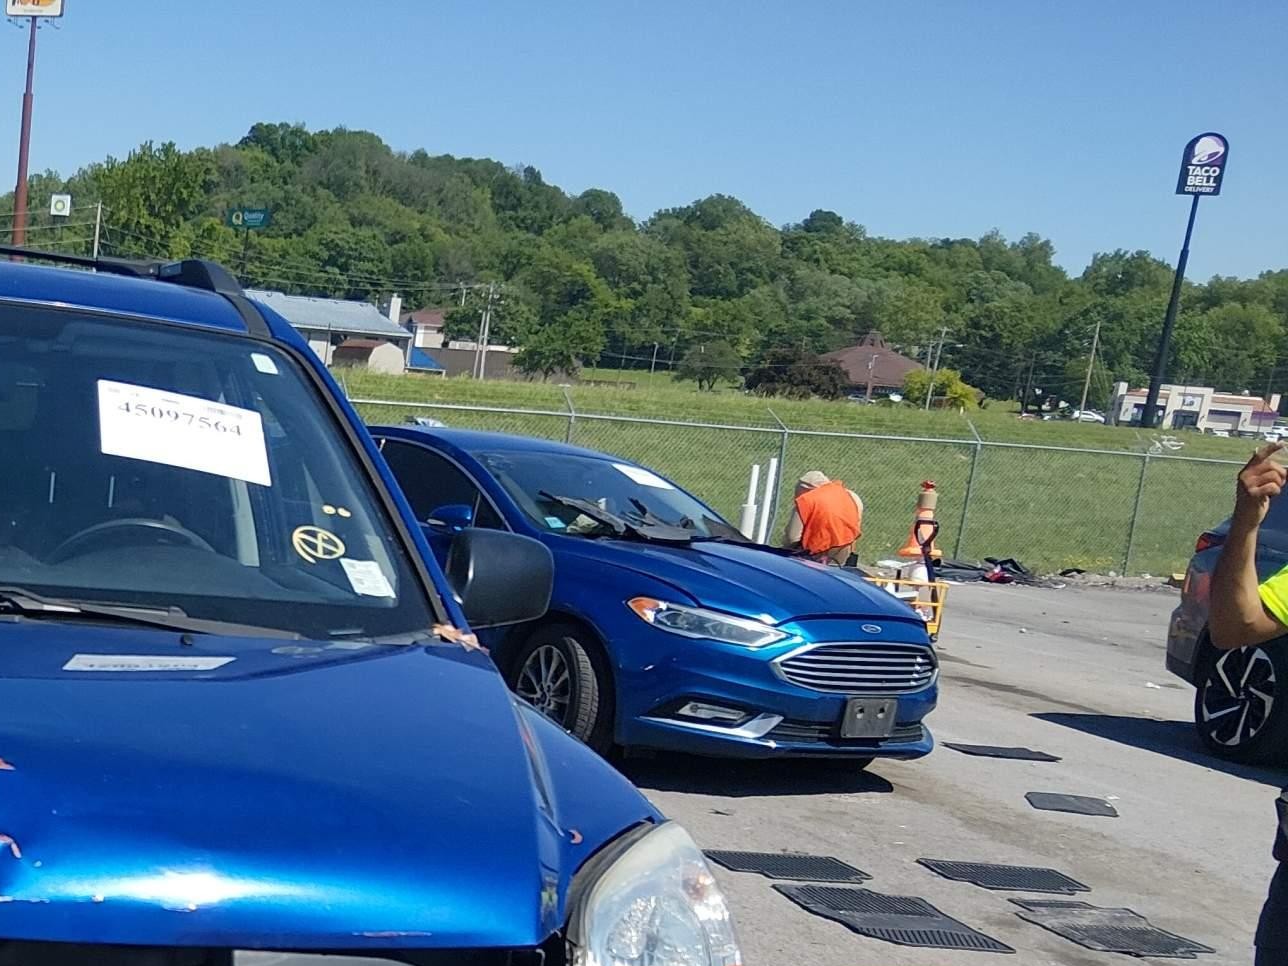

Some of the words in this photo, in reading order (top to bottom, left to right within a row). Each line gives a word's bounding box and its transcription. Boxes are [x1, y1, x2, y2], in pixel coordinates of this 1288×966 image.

[1187, 165, 1220, 177] TACO
[1187, 175, 1216, 186] BELL
[117, 401, 243, 437] 45097564
